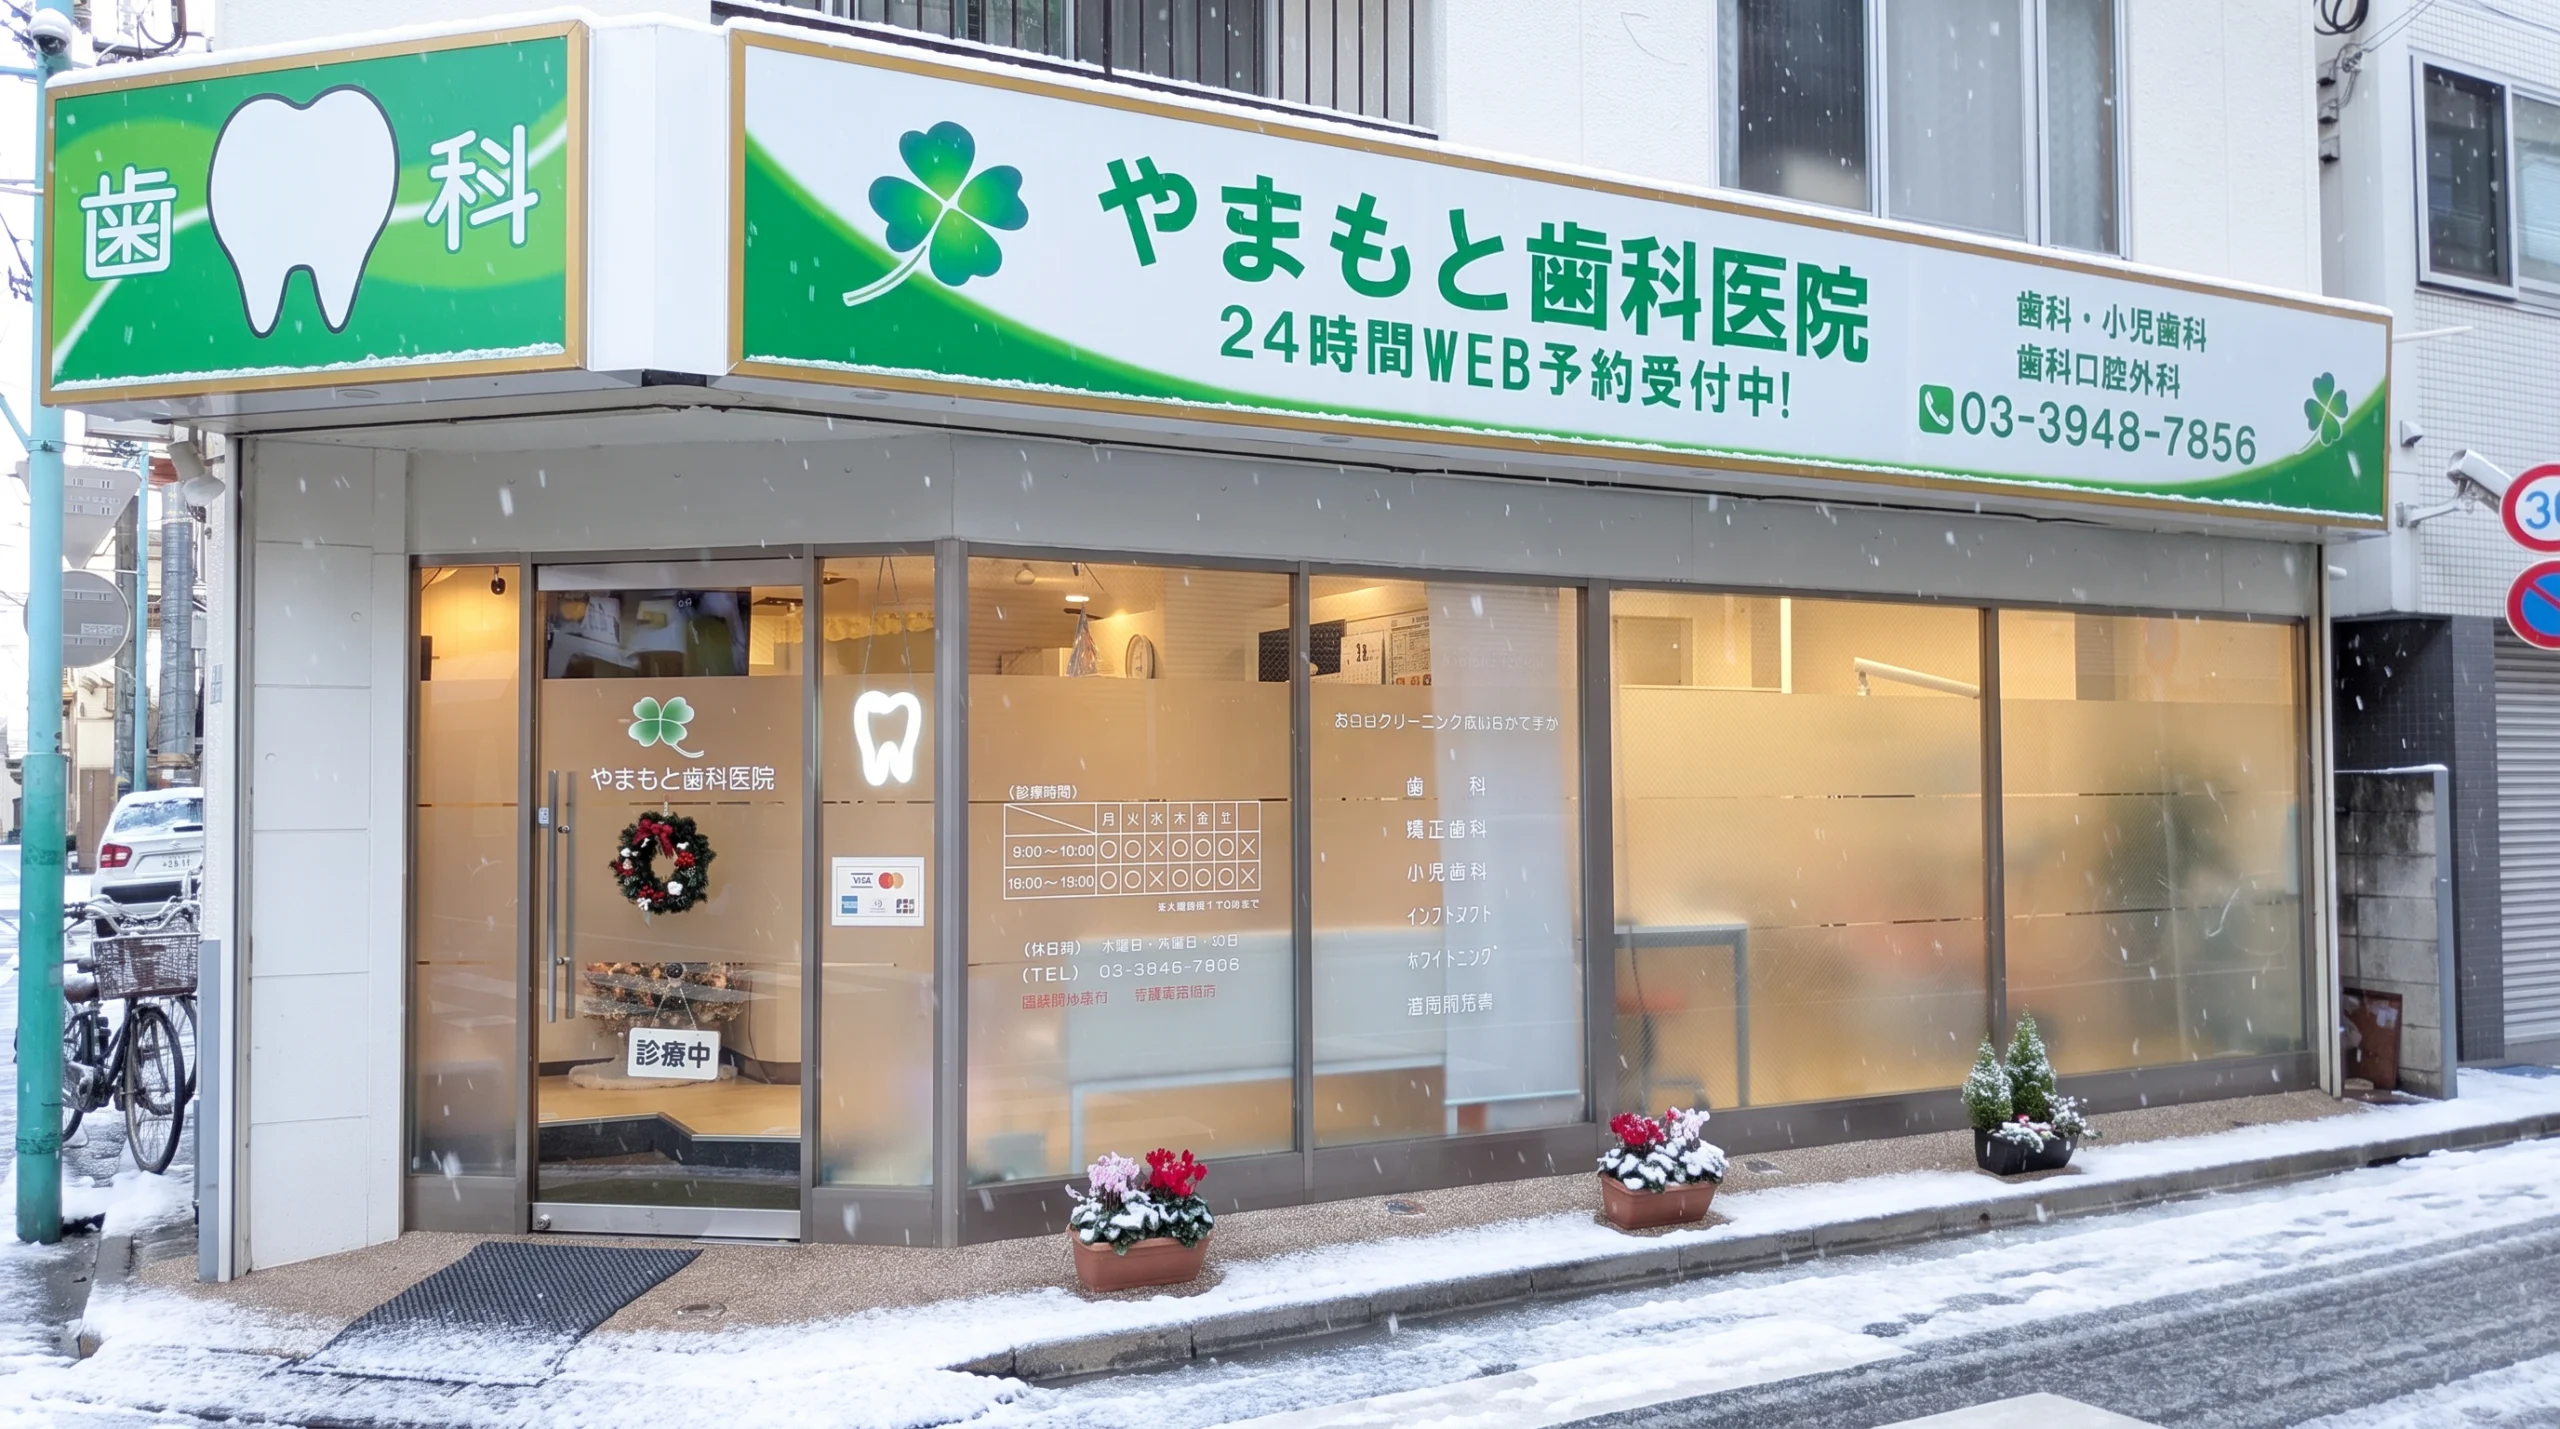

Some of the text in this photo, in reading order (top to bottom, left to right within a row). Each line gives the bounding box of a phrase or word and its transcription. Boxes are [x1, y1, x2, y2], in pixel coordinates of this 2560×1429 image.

[81, 124, 539, 279] 歯 科
[1098, 155, 1869, 364] やまもと歯科医院
[2016, 290, 2207, 353] 歯科・小児歯科
[2016, 343, 2181, 399] 歯科口腔外科
[1960, 390, 2257, 466] 03-3948-7856
[590, 765, 775, 791] やまもと歯科医院
[1469, 775, 1486, 797] 科
[1101, 812, 1115, 827] 月
[1127, 812, 1139, 826] 火
[1150, 811, 1163, 826] 水
[1173, 811, 1186, 826] 木
[1196, 811, 1209, 825] 金
[635, 1038, 711, 1070] 診療中
